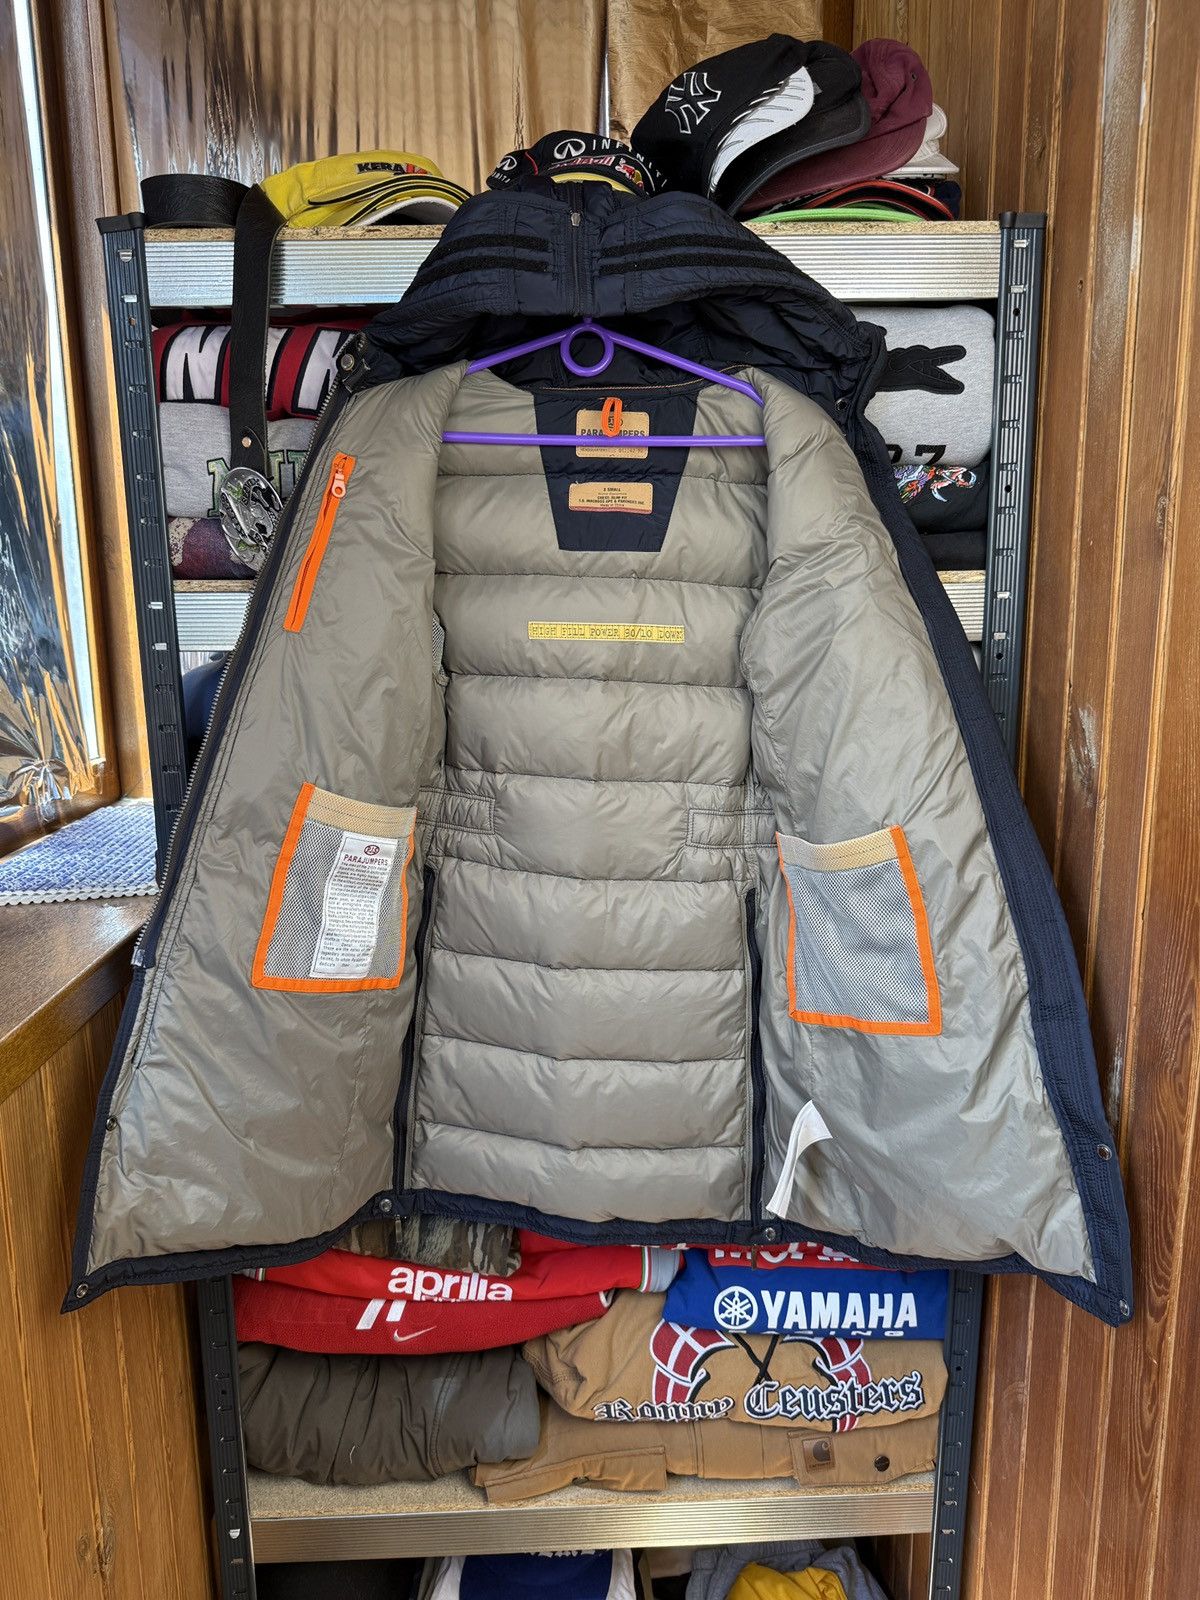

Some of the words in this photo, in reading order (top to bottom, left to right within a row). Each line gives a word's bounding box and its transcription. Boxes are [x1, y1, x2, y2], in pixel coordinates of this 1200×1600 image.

[343, 853, 389, 866] PARAJUMPERS
[387, 1266, 513, 1301] aprilia
[760, 1289, 918, 1330] YAMAHA
